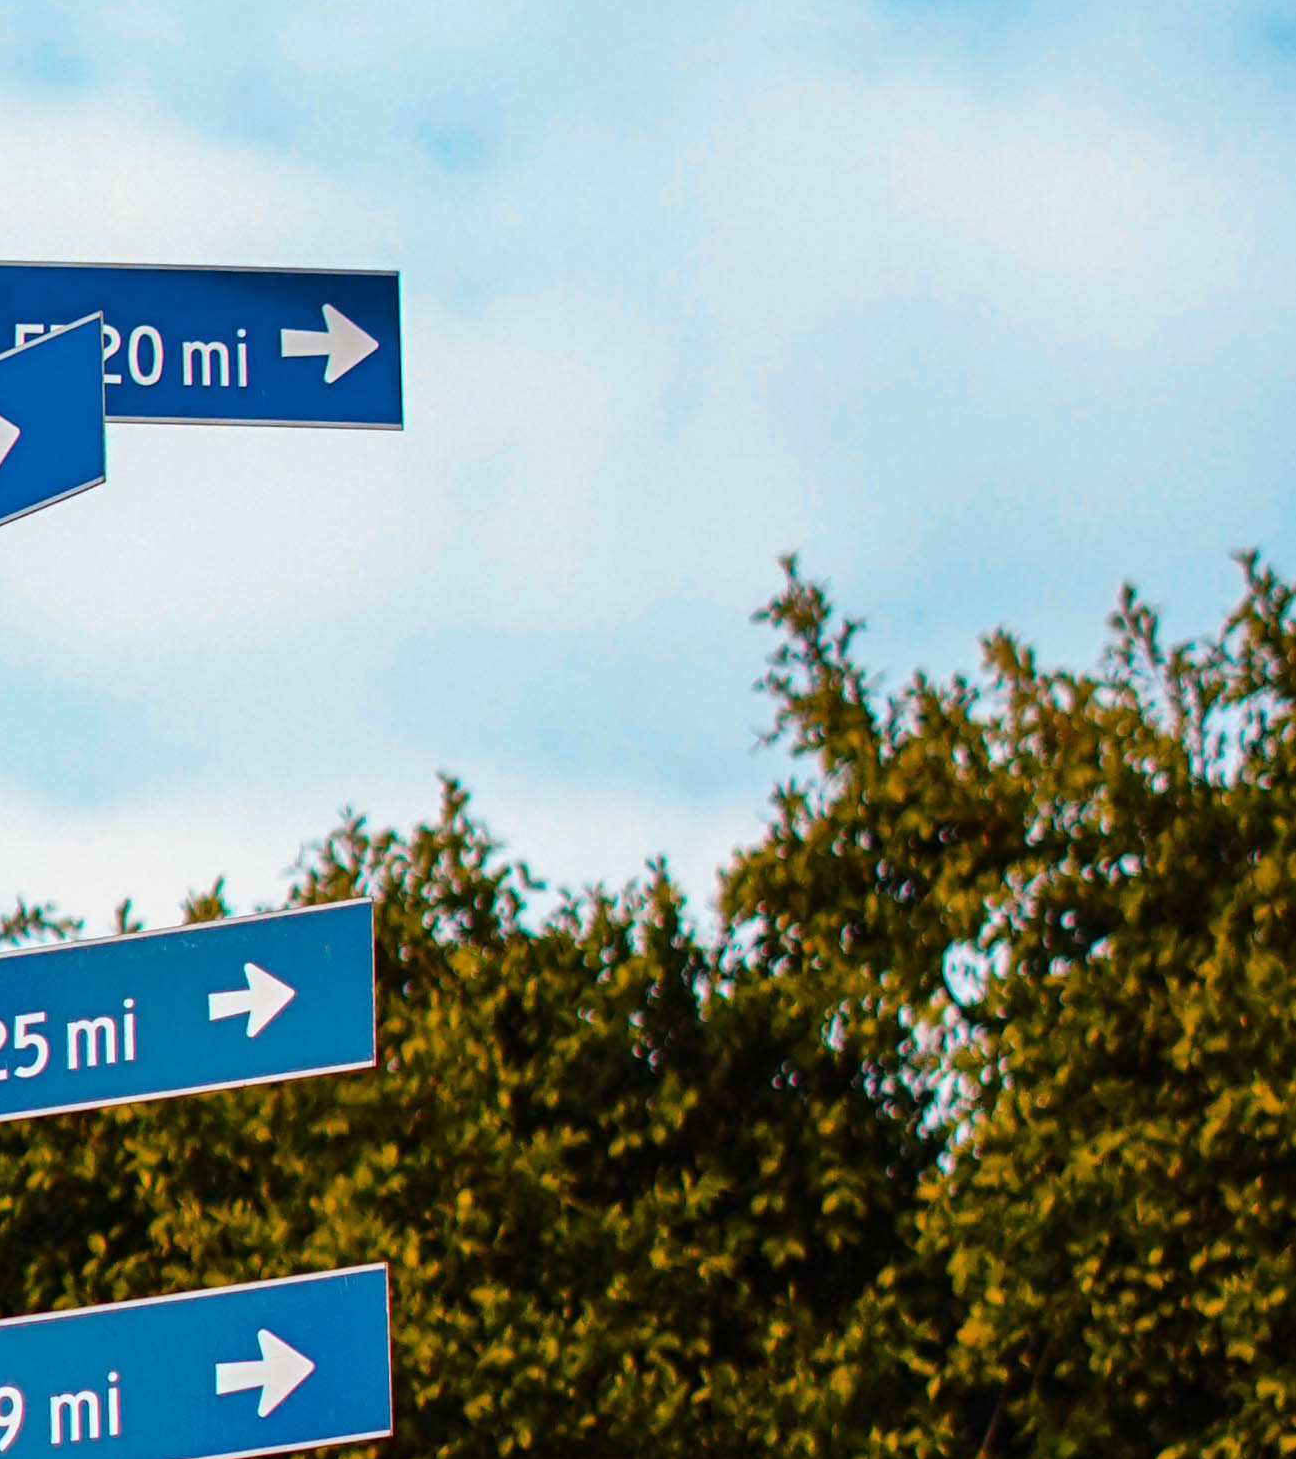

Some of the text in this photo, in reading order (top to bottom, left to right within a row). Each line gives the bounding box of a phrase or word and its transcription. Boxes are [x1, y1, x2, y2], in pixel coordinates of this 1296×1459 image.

[183, 328, 248, 387] mi
[67, 998, 136, 1070] mi
[50, 1371, 121, 1445] mi
